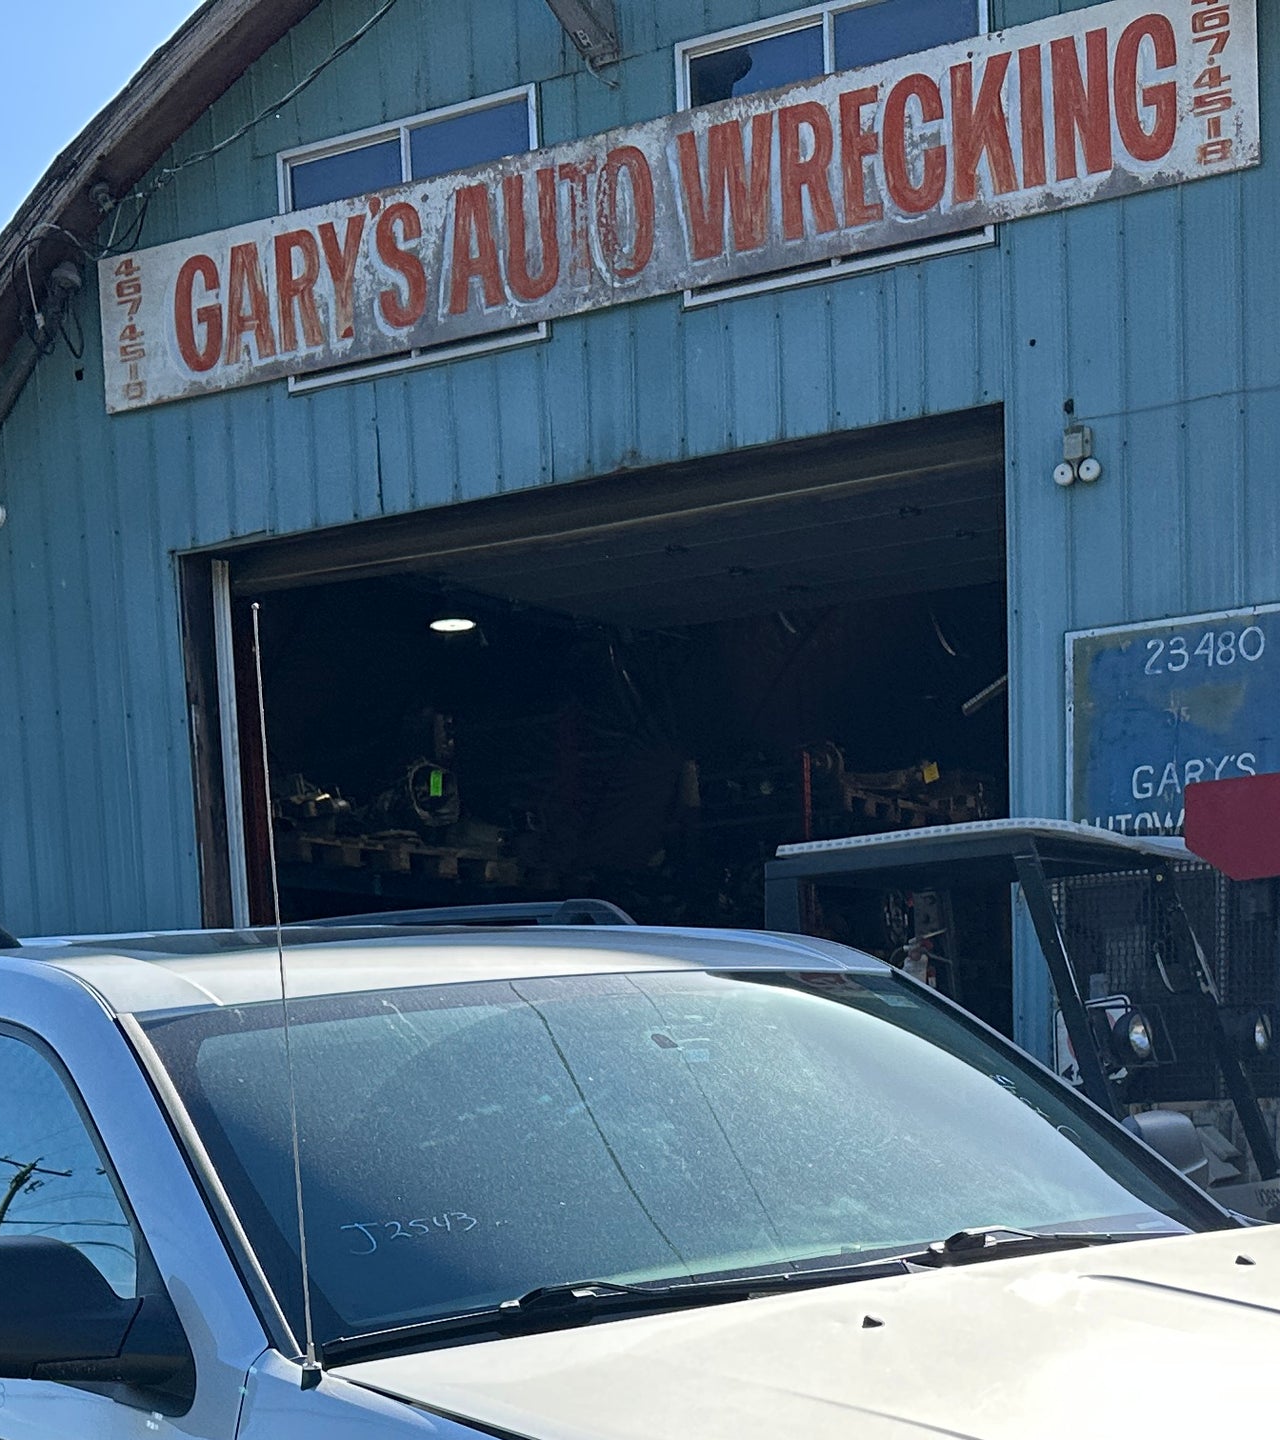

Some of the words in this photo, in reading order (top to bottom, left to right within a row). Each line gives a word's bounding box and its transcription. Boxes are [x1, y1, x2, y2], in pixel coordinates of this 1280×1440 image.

[174, 196, 426, 373] GARY'S
[448, 145, 655, 315] AUTO
[676, 13, 1177, 262] WRECKING
[1144, 626, 1265, 675] 23480
[1131, 752, 1257, 799] GARY'S
[340, 1211, 478, 1255] J2543
